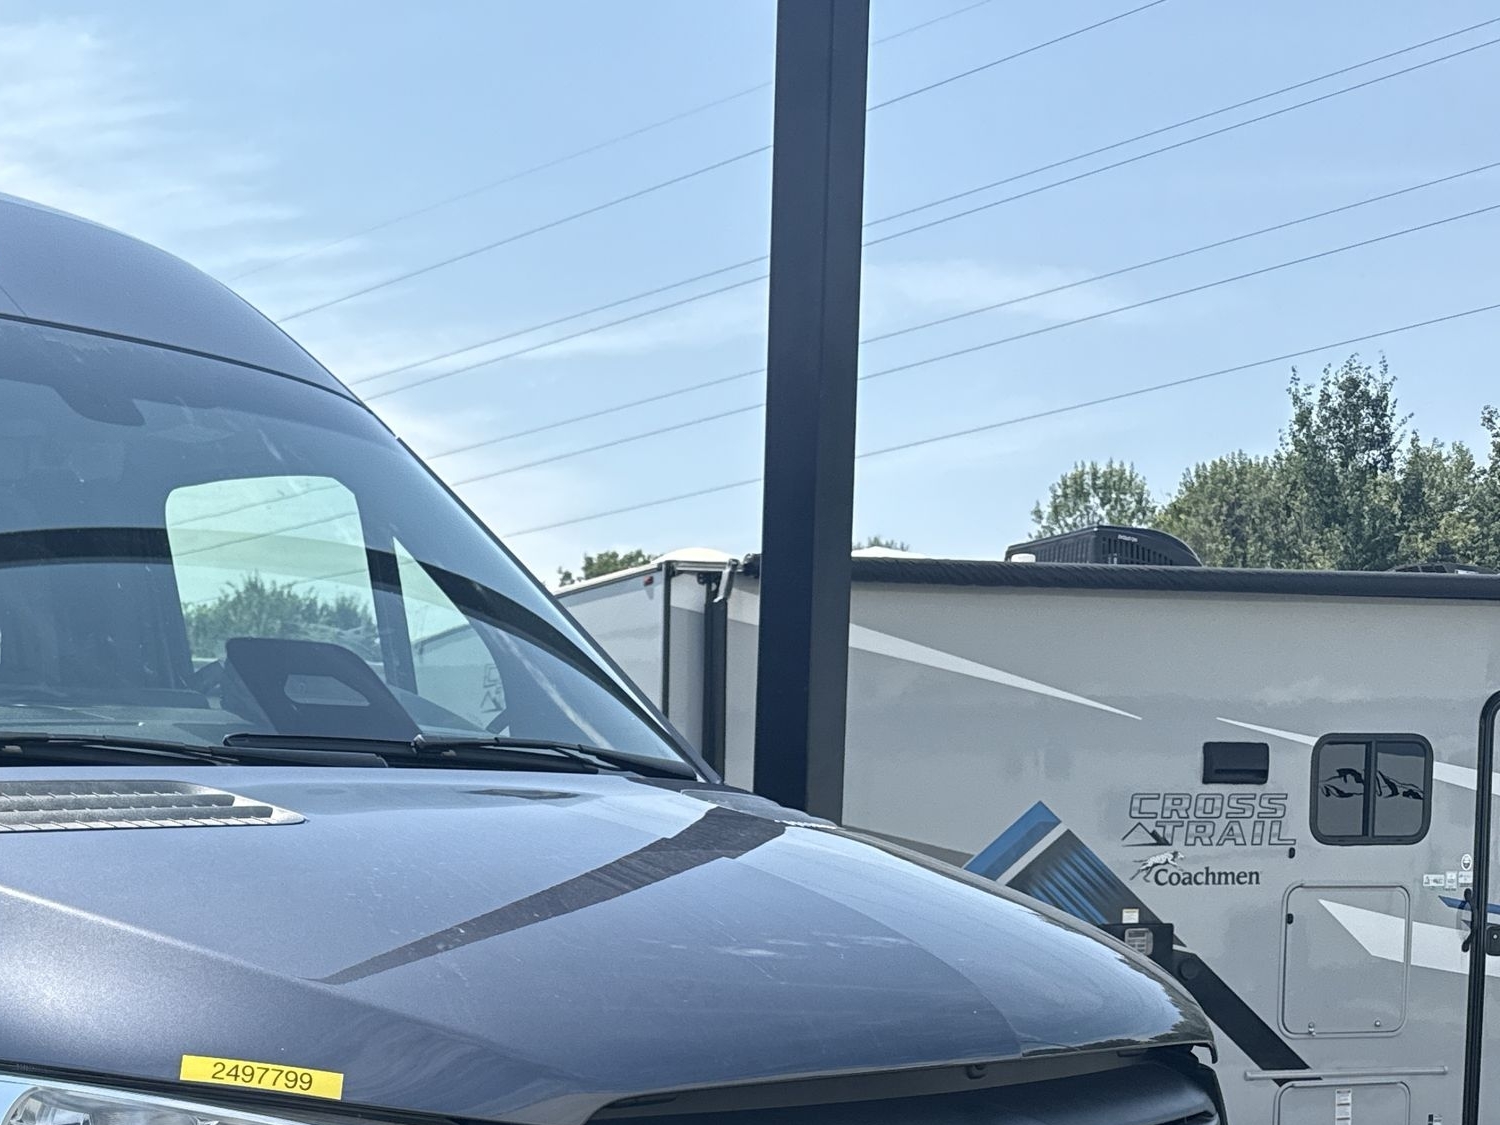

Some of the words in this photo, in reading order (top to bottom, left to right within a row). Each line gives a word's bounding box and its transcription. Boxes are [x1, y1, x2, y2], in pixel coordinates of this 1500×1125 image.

[1129, 793, 1288, 819] CROSS
[1155, 820, 1296, 846] TRAIL
[1153, 866, 1260, 886] Coachmen
[211, 1061, 313, 1092] 2497799
